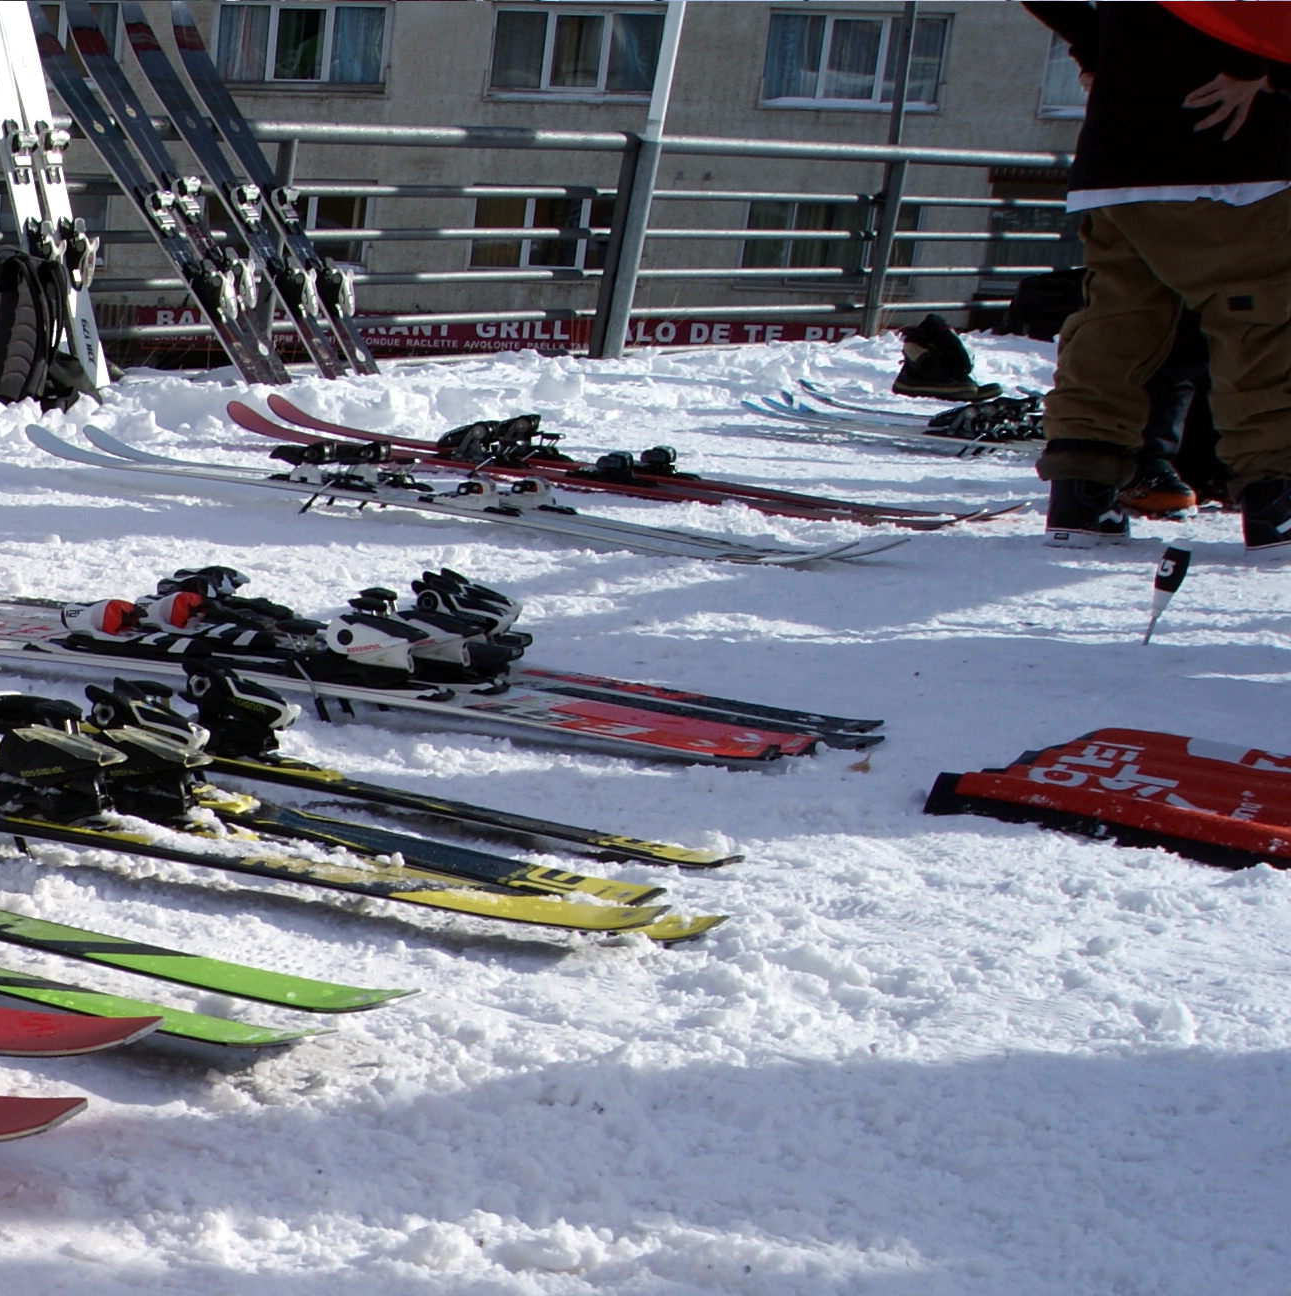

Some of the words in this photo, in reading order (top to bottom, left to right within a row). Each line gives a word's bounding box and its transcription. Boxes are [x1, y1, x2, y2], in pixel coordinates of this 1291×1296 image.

[475, 321, 570, 340] GRILL
[690, 323, 731, 344] DE
[406, 338, 458, 348] RACLETTE
